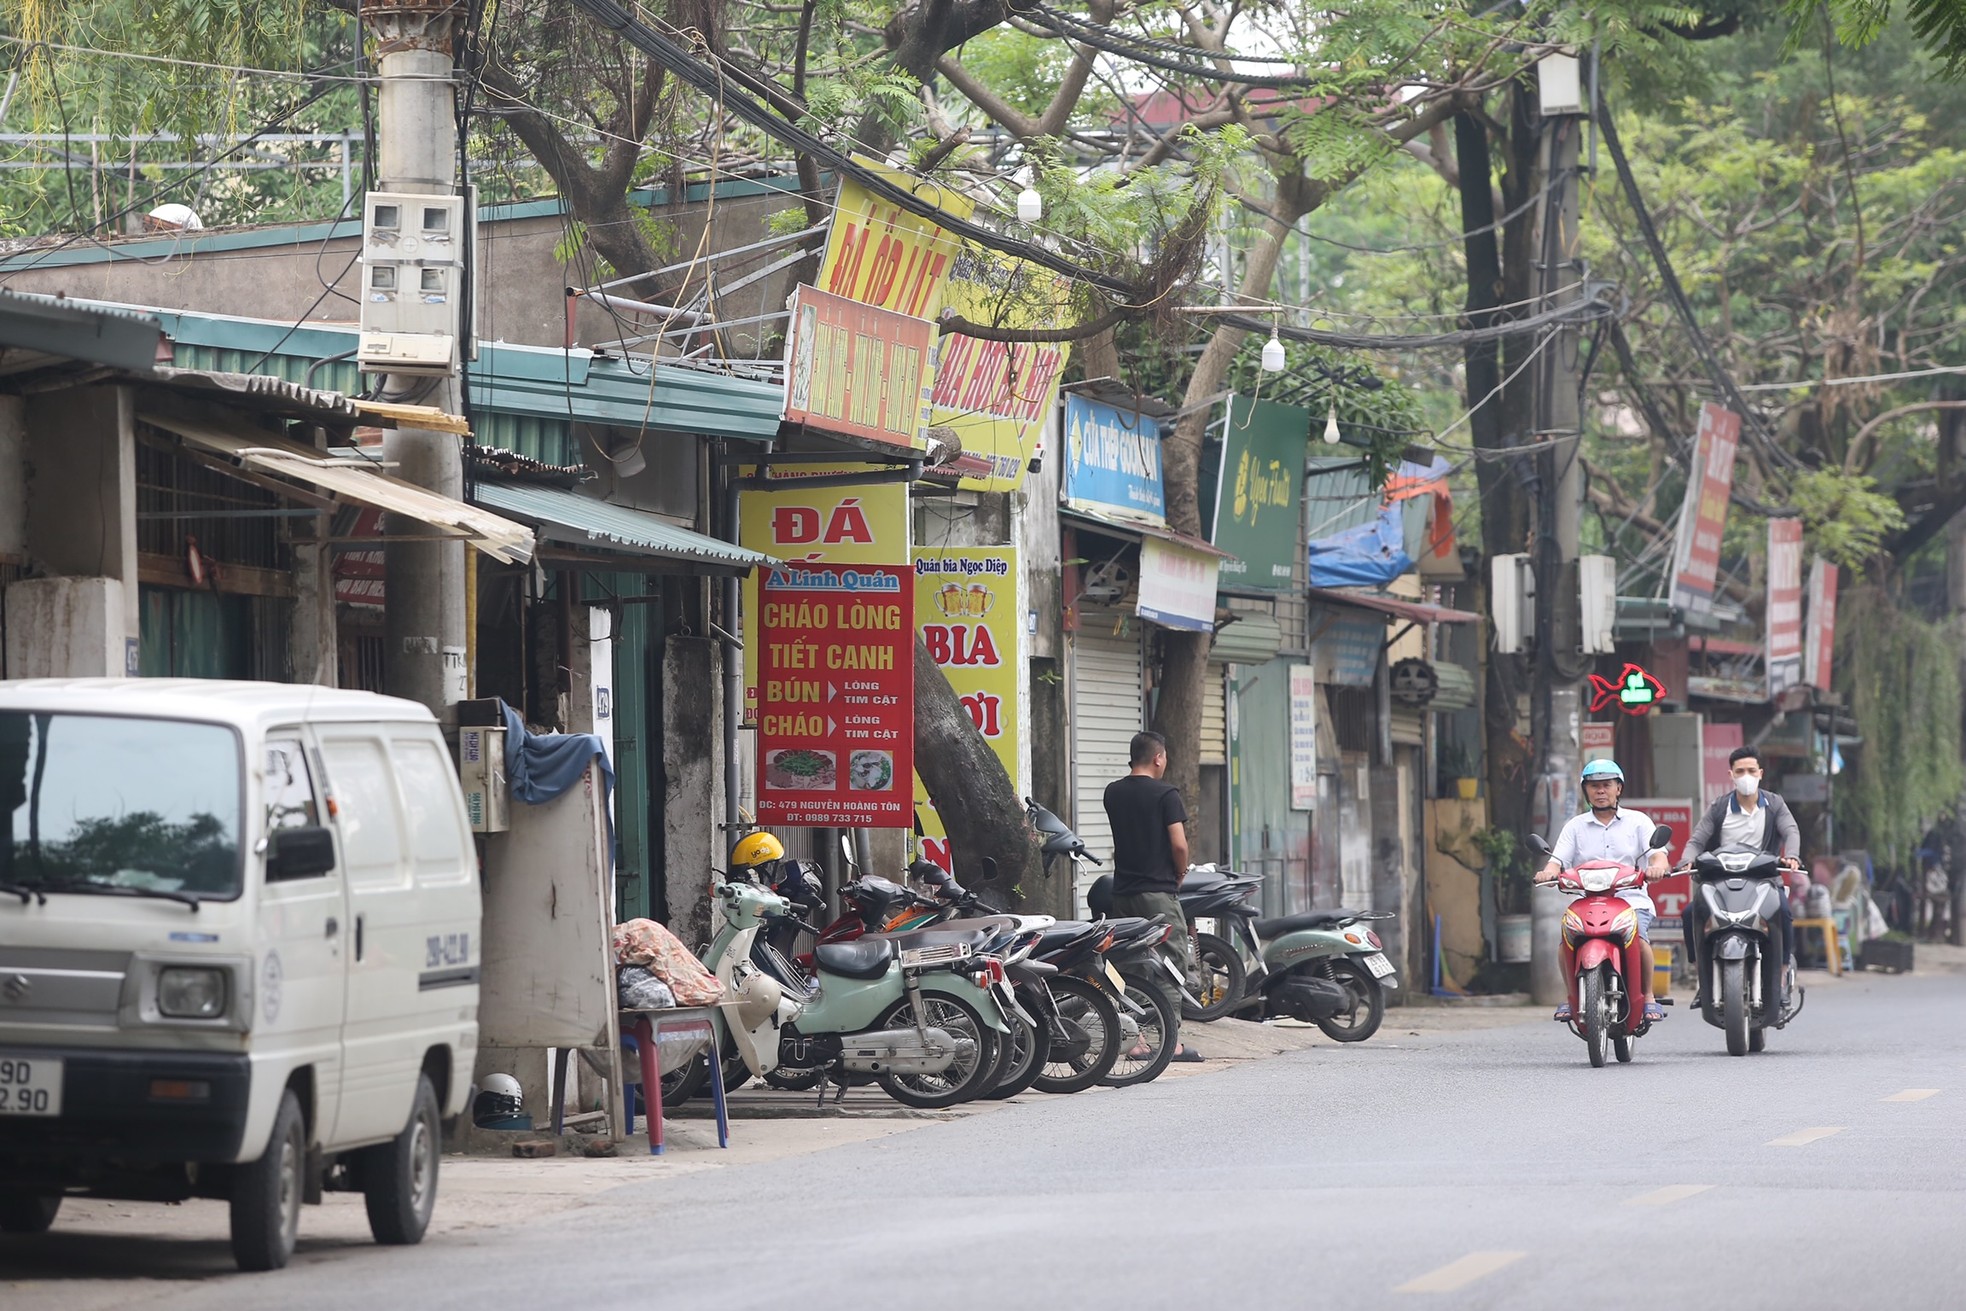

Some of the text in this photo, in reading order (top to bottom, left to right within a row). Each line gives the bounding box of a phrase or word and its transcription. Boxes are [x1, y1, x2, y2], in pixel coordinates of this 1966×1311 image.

[772, 498, 873, 544] ĐÁ
[916, 558, 1008, 577] Quán bia Ngọc Diệp
[768, 569, 899, 591] A Linh Quán
[764, 599, 901, 631] CHÁO LÒNG
[769, 636, 894, 671] TIẾT CANH
[923, 625, 999, 666] BIA
[767, 675, 820, 703] BÚN
[844, 680, 880, 691] LÒNG
[844, 694, 899, 707] TIM CẬT
[763, 710, 824, 737] CHÁO
[844, 714, 880, 725] LÒNG
[844, 729, 899, 741] TIM CẬT
[759, 798, 900, 810] ĐC: 479 NGUYỄN HOÀNG TÔN
[787, 813, 872, 823] ĐT: 0989 733 715
